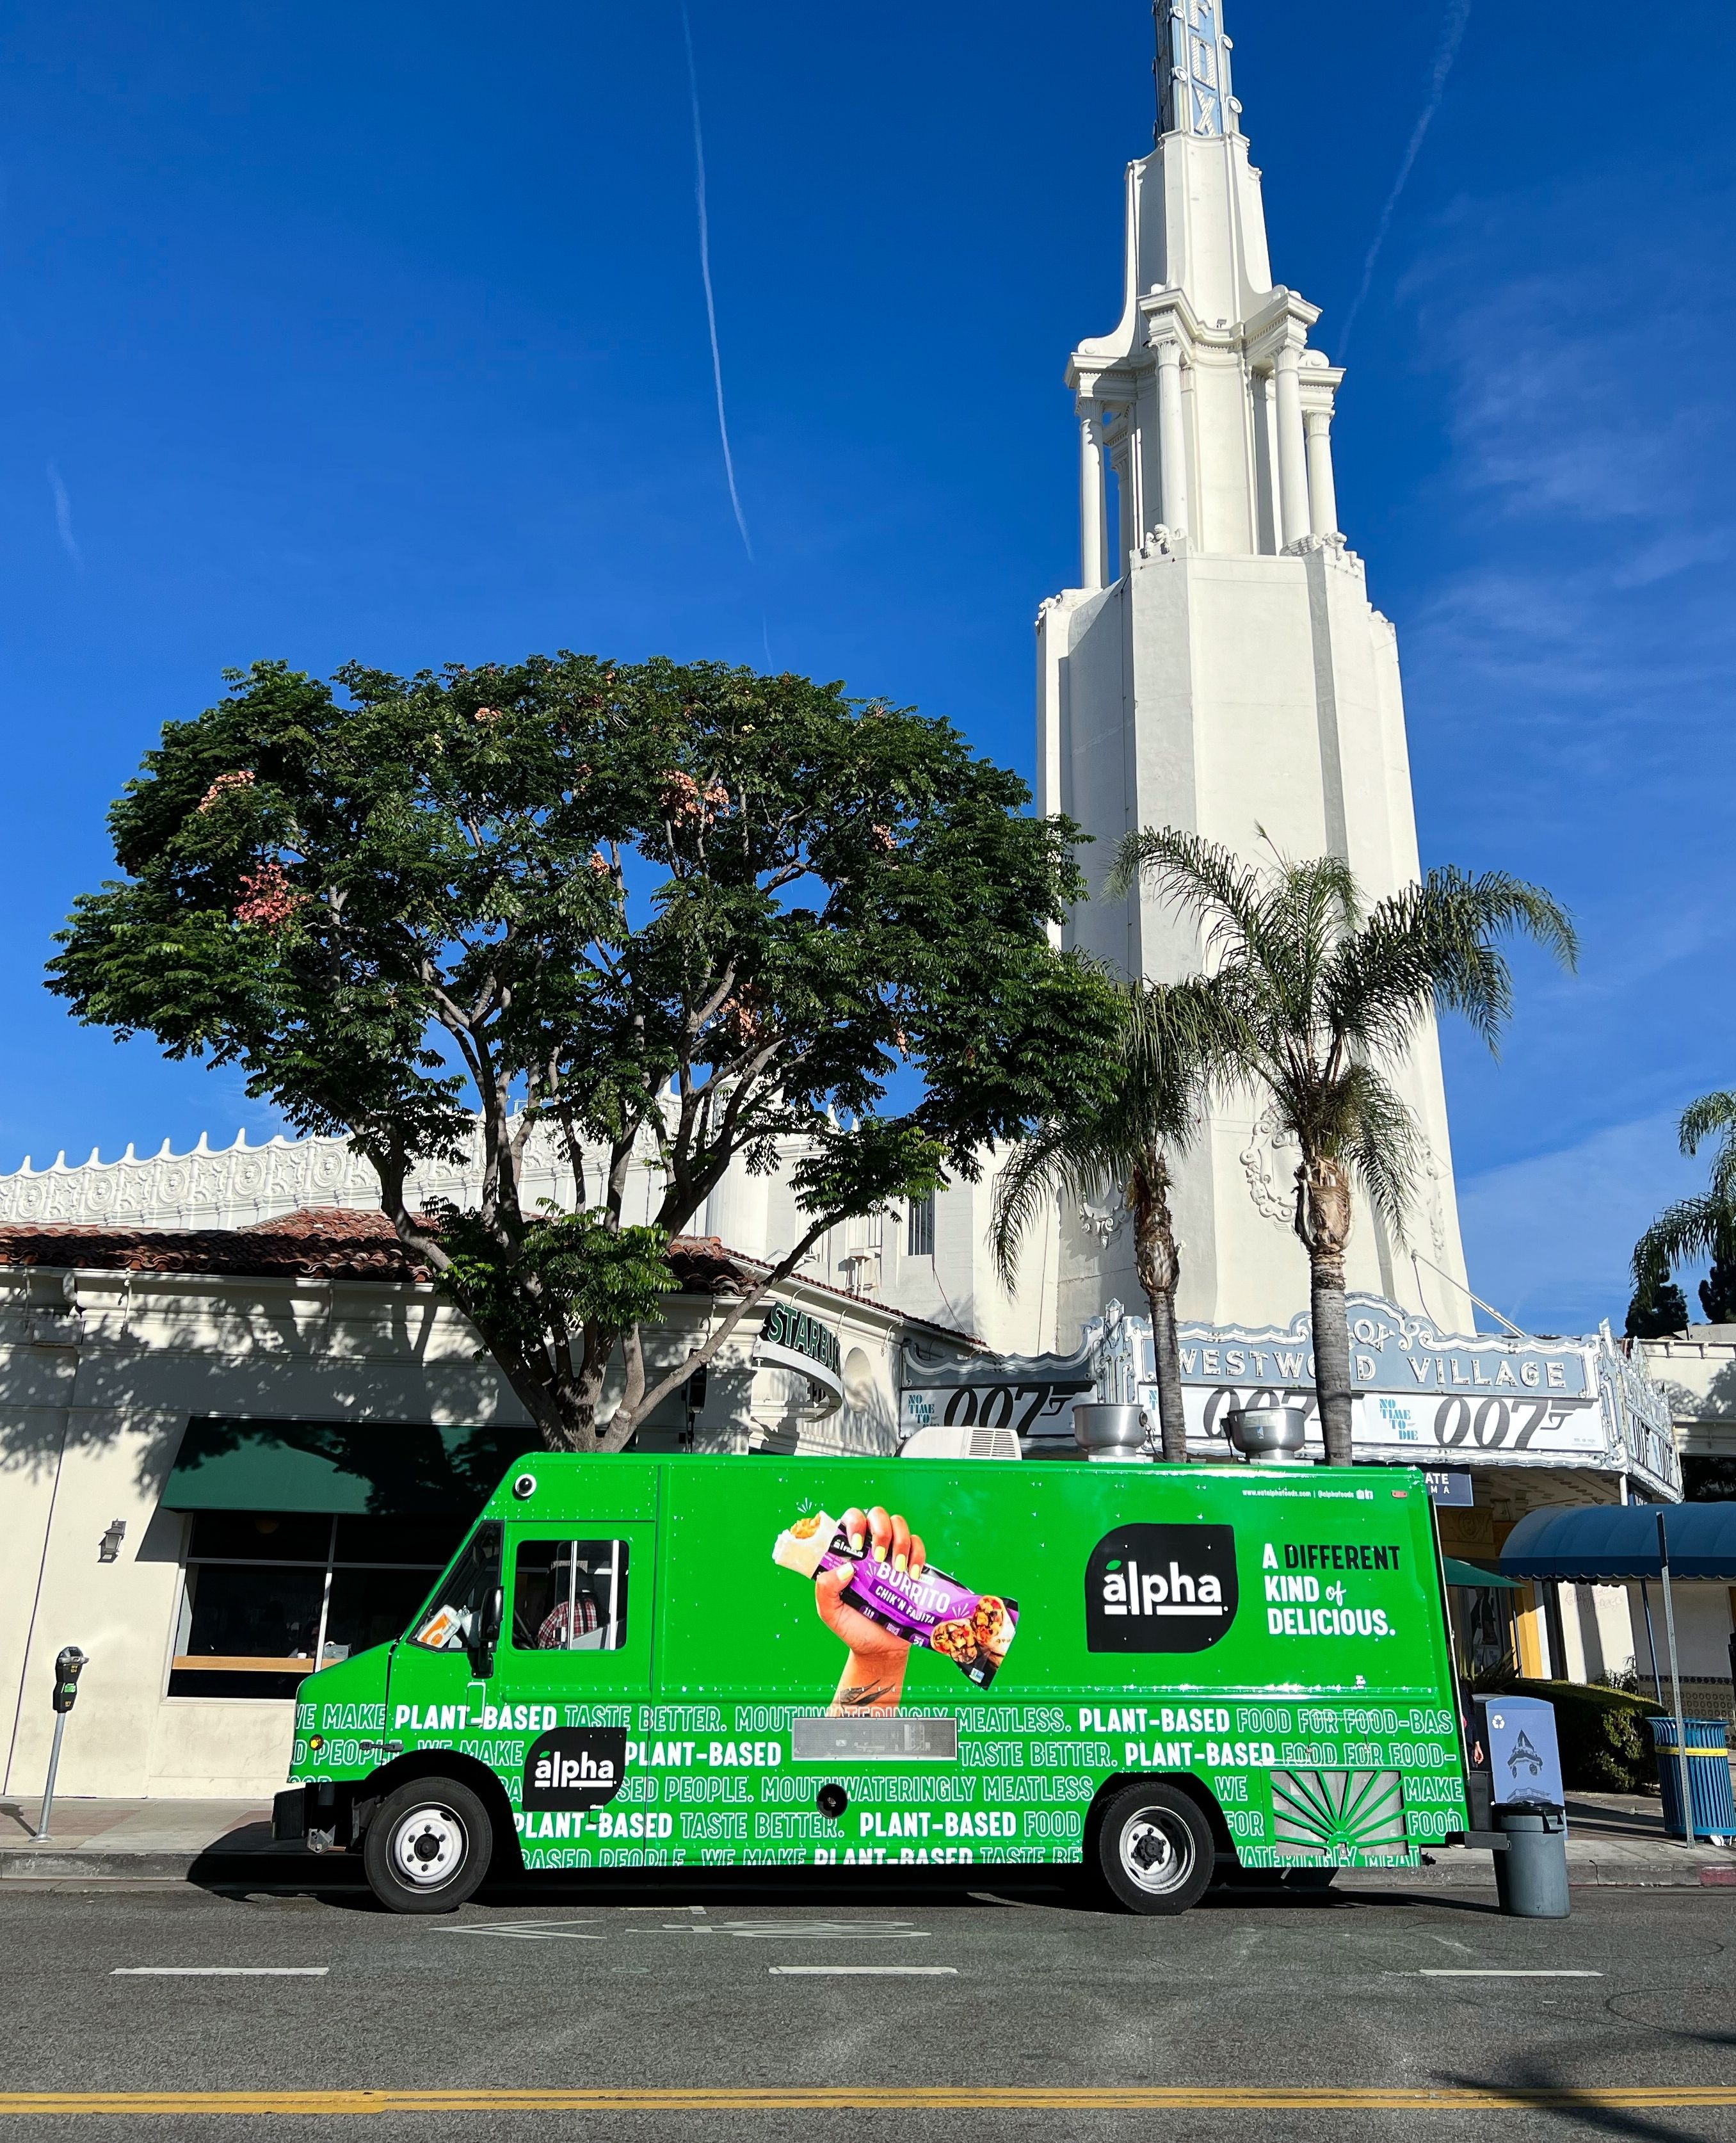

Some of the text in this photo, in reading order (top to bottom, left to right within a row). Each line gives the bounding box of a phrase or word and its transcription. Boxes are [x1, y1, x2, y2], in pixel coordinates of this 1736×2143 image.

[1179, 1348, 1566, 1388] WESTWD VILLAGE
[908, 1395, 922, 1404] NO
[908, 1404, 935, 1414] TIME
[944, 1386, 1051, 1435] 007
[1379, 1398, 1396, 1409] NO
[915, 1414, 930, 1424] TO
[1380, 1409, 1411, 1419] TIME
[1389, 1419, 1406, 1429] TO
[1434, 1396, 1548, 1448] 007
[1399, 1430, 1419, 1440] DIE
[1262, 1543, 1401, 1571] A DIFFERENT
[876, 1561, 951, 1613] BURRITO
[1264, 1576, 1347, 1606] KIND of
[906, 1608, 935, 1624] FAJITA
[1267, 1608, 1395, 1636] DELICIOUS.
[322, 1704, 386, 1729] MAKE
[395, 1704, 557, 1731] PLANT-BASED
[565, 1705, 632, 1731] TASTE
[638, 1706, 727, 1732] BETTER.
[956, 1707, 1072, 1733] MEATLESS.
[1079, 1708, 1230, 1732] PLANT-BASED
[1236, 1708, 1292, 1733] FOOD
[1298, 1708, 1339, 1734] FOR
[1344, 1708, 1454, 1735] FOOD-BAS
[624, 1742, 782, 1767] PLANT-BASED
[958, 1742, 1023, 1767] TASTE
[1030, 1742, 1118, 1767] BETTER.
[1125, 1742, 1275, 1767] PLANT-BASED
[1282, 1742, 1337, 1766] FOOD
[1343, 1742, 1383, 1766] FOR
[664, 1776, 755, 1802] PEOPLE.
[983, 1775, 1095, 1802] MEATLESS
[1214, 1776, 1248, 1801] WE
[1402, 1776, 1465, 1802] MAKE
[512, 1812, 673, 1838] PLANT-BASED
[680, 1813, 748, 1839] TASTE
[754, 1813, 845, 1839] BETTER.
[860, 1811, 1017, 1838] PLANT-BASED
[1024, 1811, 1081, 1838] FOOD
[1408, 1811, 1464, 1837] FOOD
